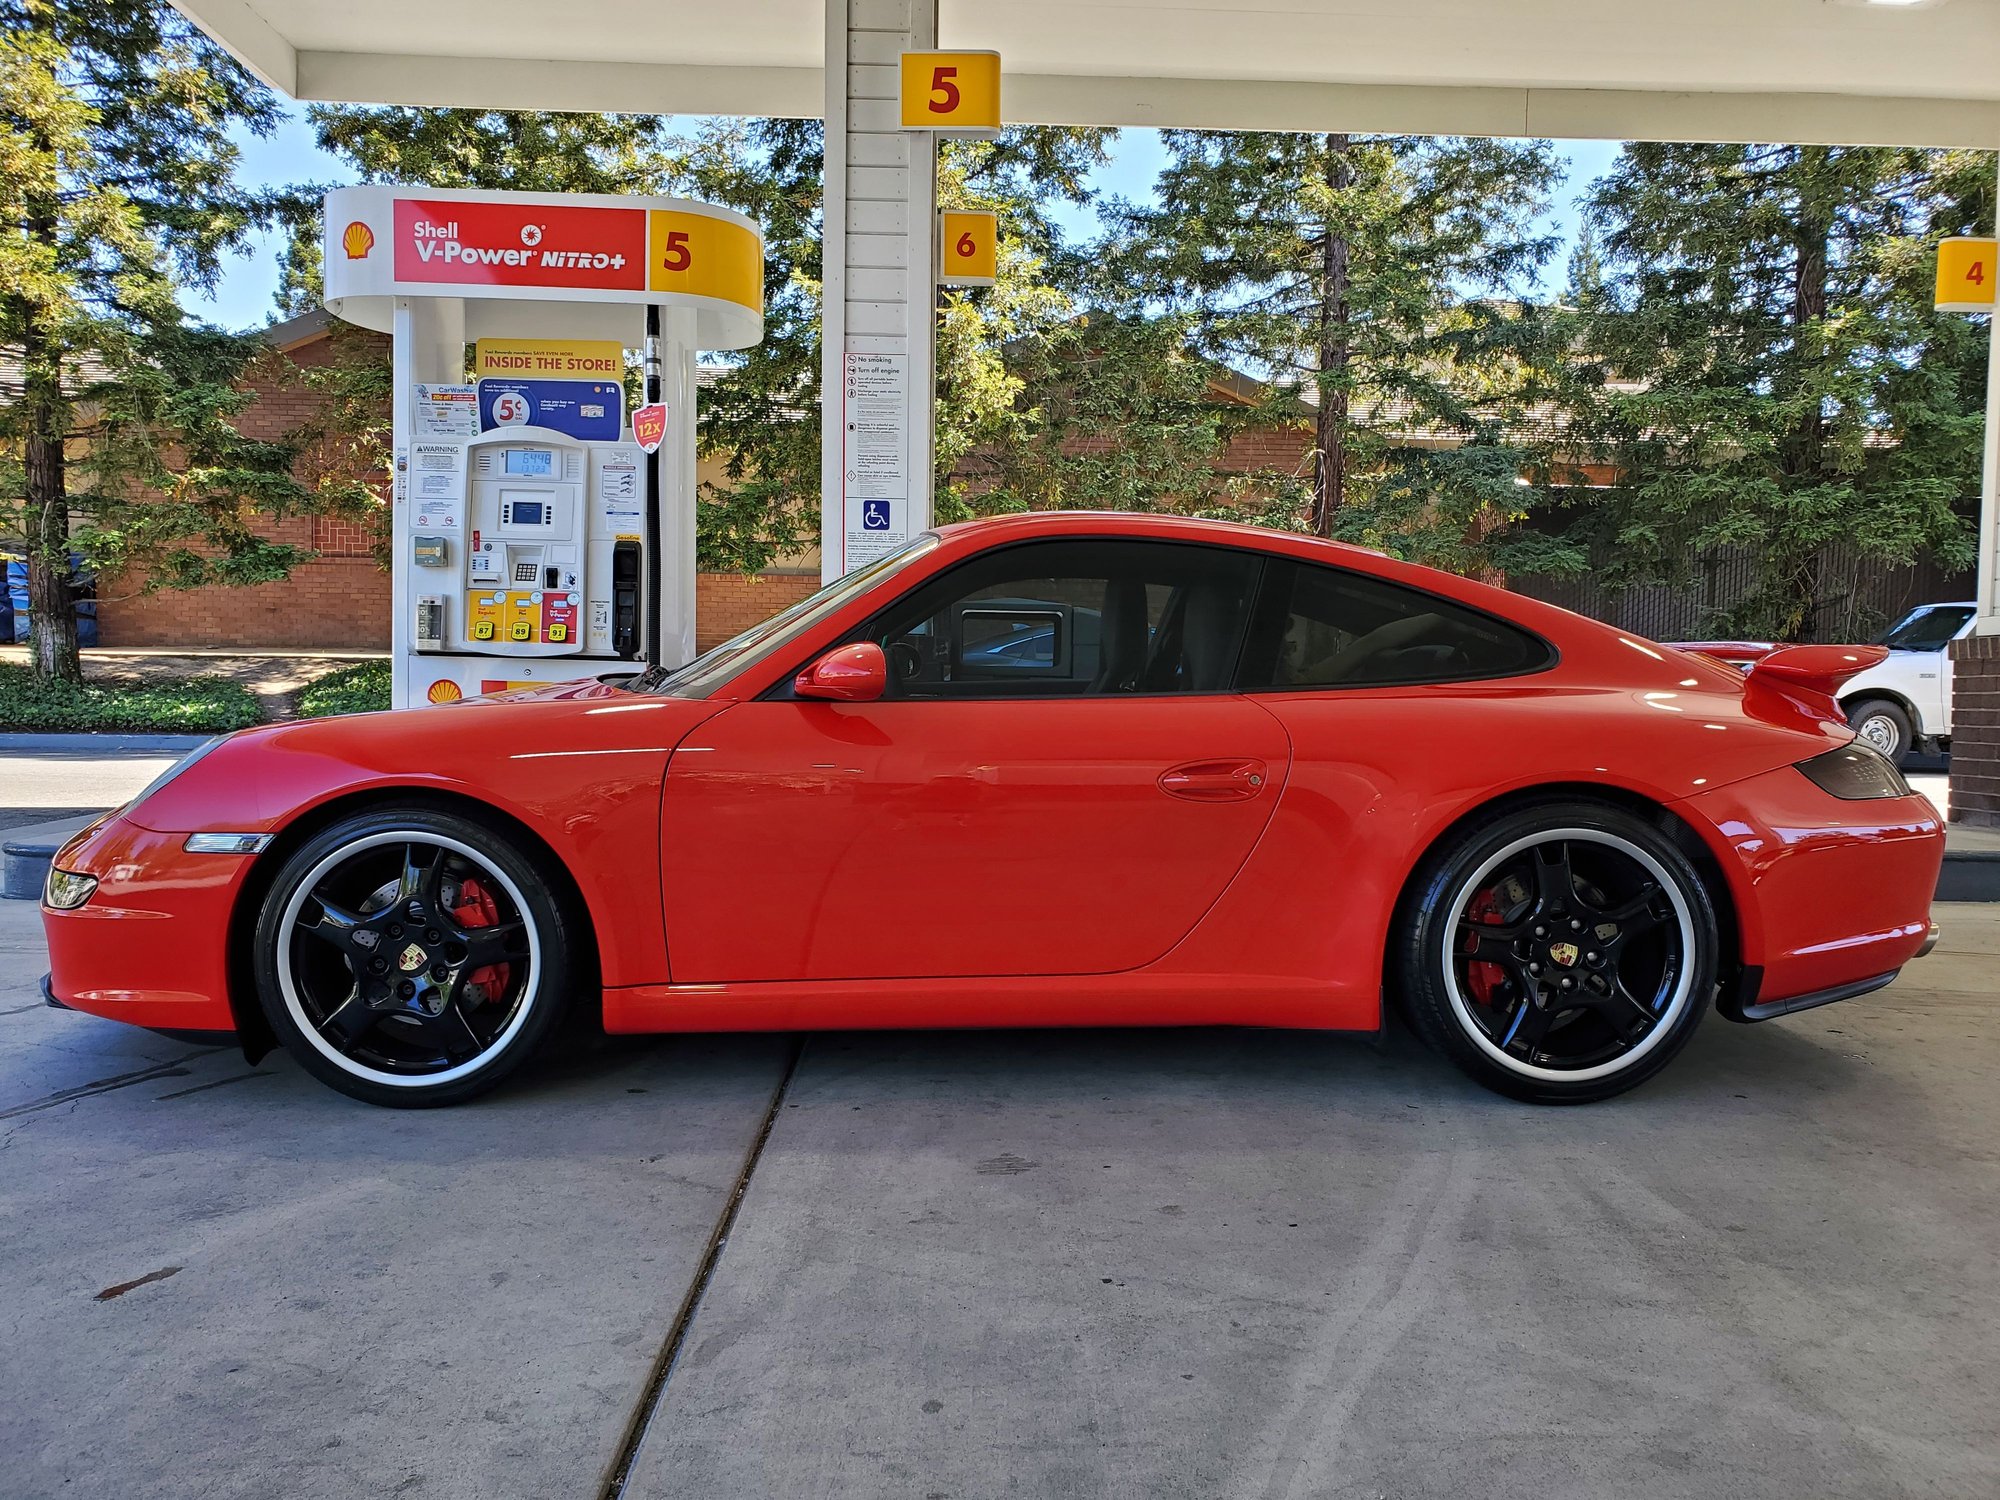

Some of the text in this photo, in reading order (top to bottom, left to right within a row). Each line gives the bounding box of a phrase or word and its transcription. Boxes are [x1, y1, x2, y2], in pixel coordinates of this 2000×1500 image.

[928, 67, 960, 113] 5
[414, 221, 458, 239] Shell
[663, 231, 692, 272] 5
[956, 232, 976, 258] 6
[1966, 261, 1984, 286] 4
[484, 356, 616, 372] INSIDE THE STORE!
[868, 356, 892, 364] smoking
[478, 627, 489, 635] 87
[515, 628, 526, 636] 89
[552, 629, 562, 637] 91
